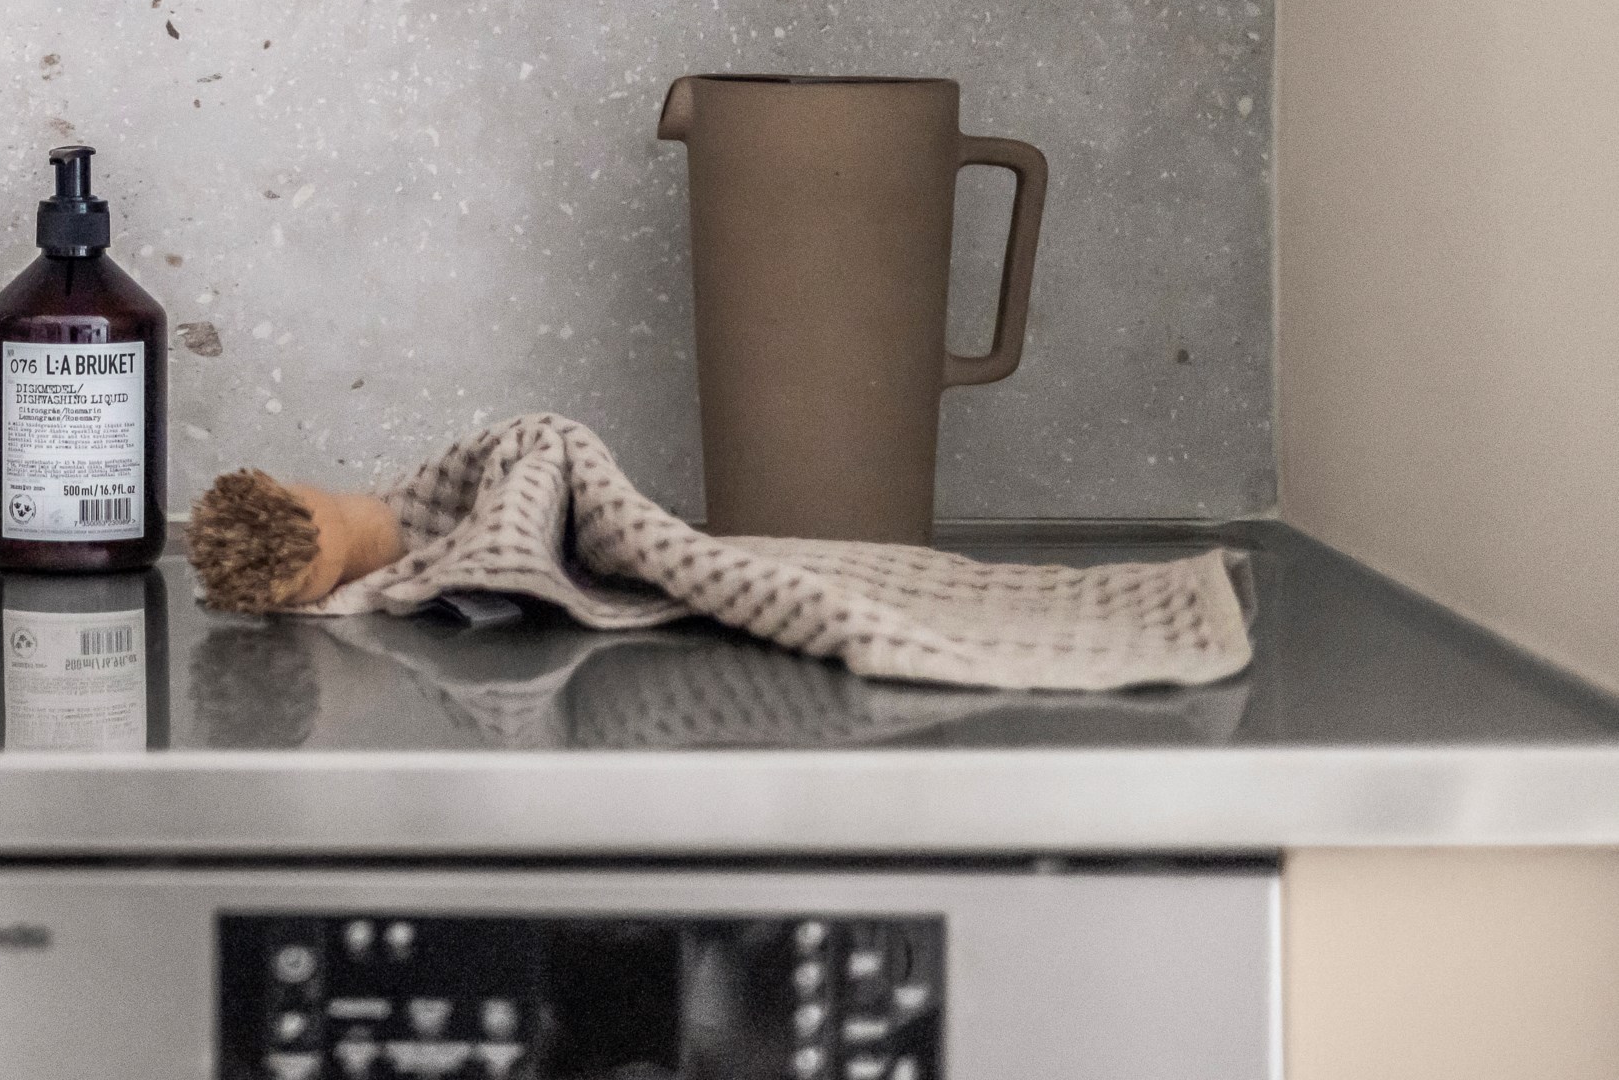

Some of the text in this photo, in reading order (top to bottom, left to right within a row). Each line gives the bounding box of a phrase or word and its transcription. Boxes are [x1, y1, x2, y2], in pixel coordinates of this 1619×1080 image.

[10, 353, 135, 375] 076 L:A BRUKET
[16, 383, 84, 394] DISKMEDEL/
[16, 394, 129, 406] DISHWASHING LIQUID
[63, 485, 80, 496] 500
[100, 485, 117, 496] 16.9
